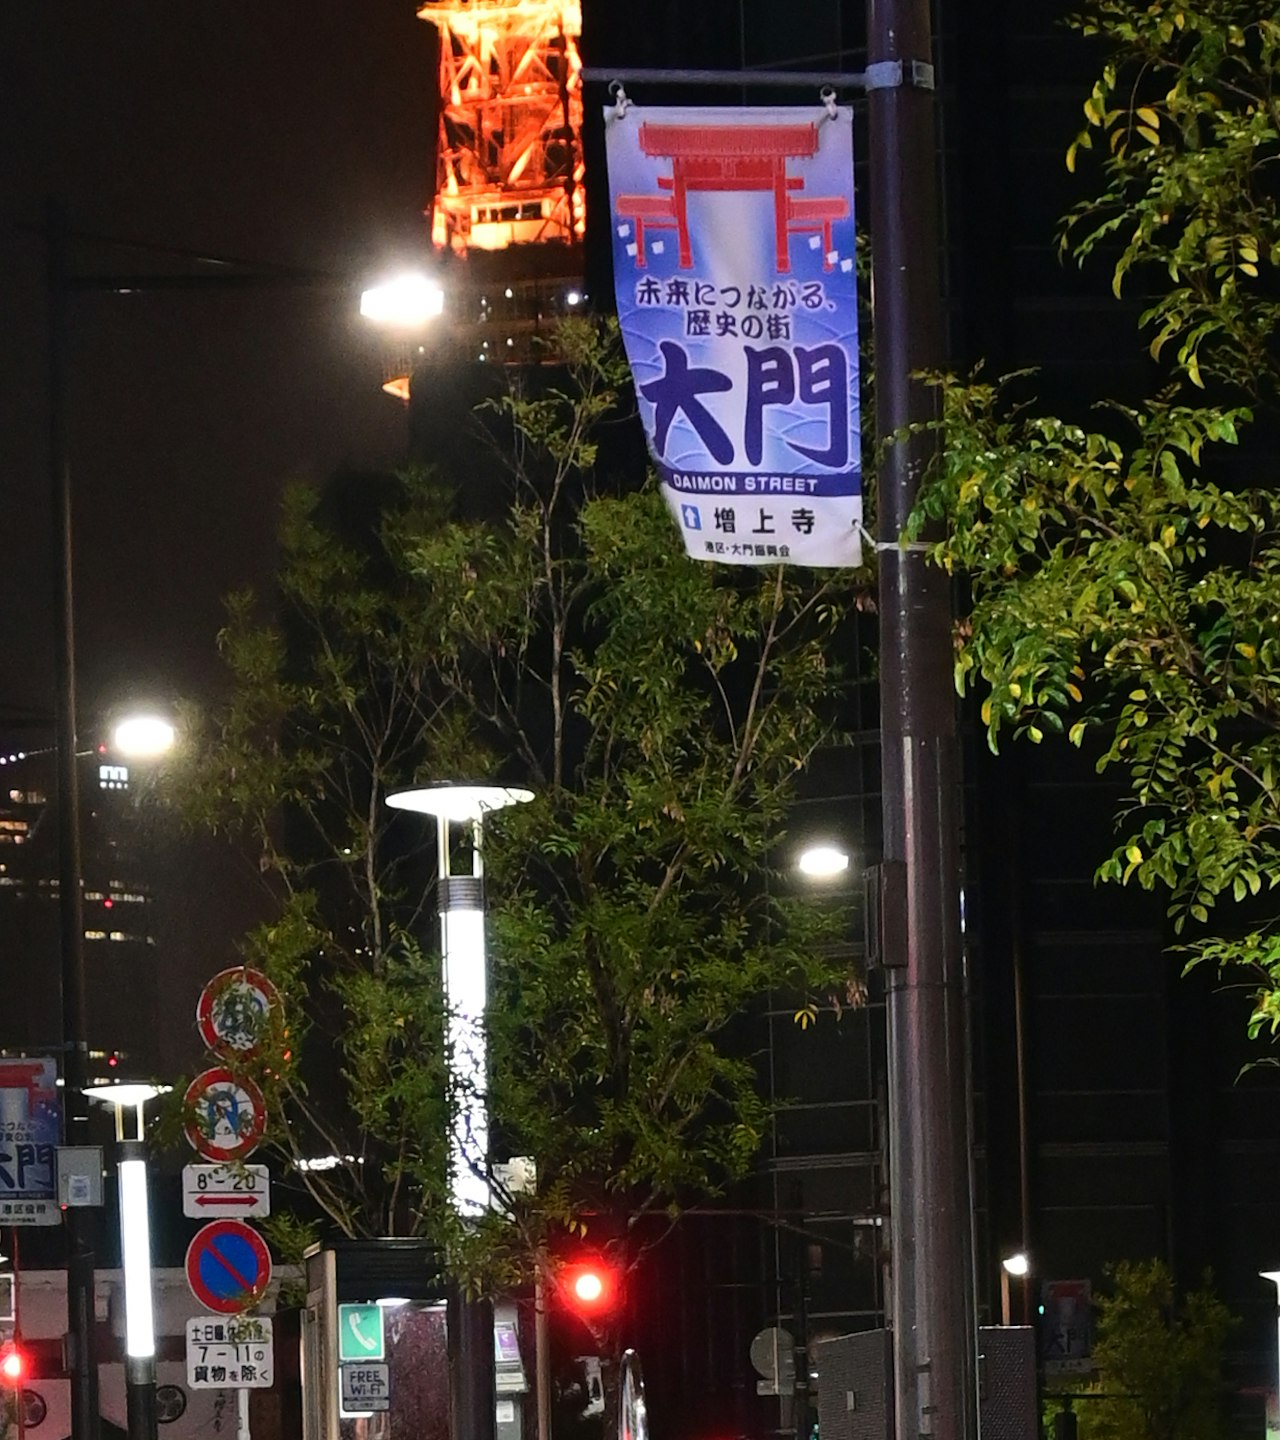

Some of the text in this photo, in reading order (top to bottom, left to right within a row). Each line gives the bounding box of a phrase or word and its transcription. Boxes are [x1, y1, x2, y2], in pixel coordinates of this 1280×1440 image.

[636, 278, 837, 312] 未来につながる、
[686, 310, 791, 340] 歴史の街
[640, 340, 850, 468] 大門
[673, 474, 818, 493] DAIMON STREET
[714, 506, 816, 535] 増上寺
[193, 1364, 269, 1383] 貨物を除く
[349, 1370, 380, 1383] FREE
